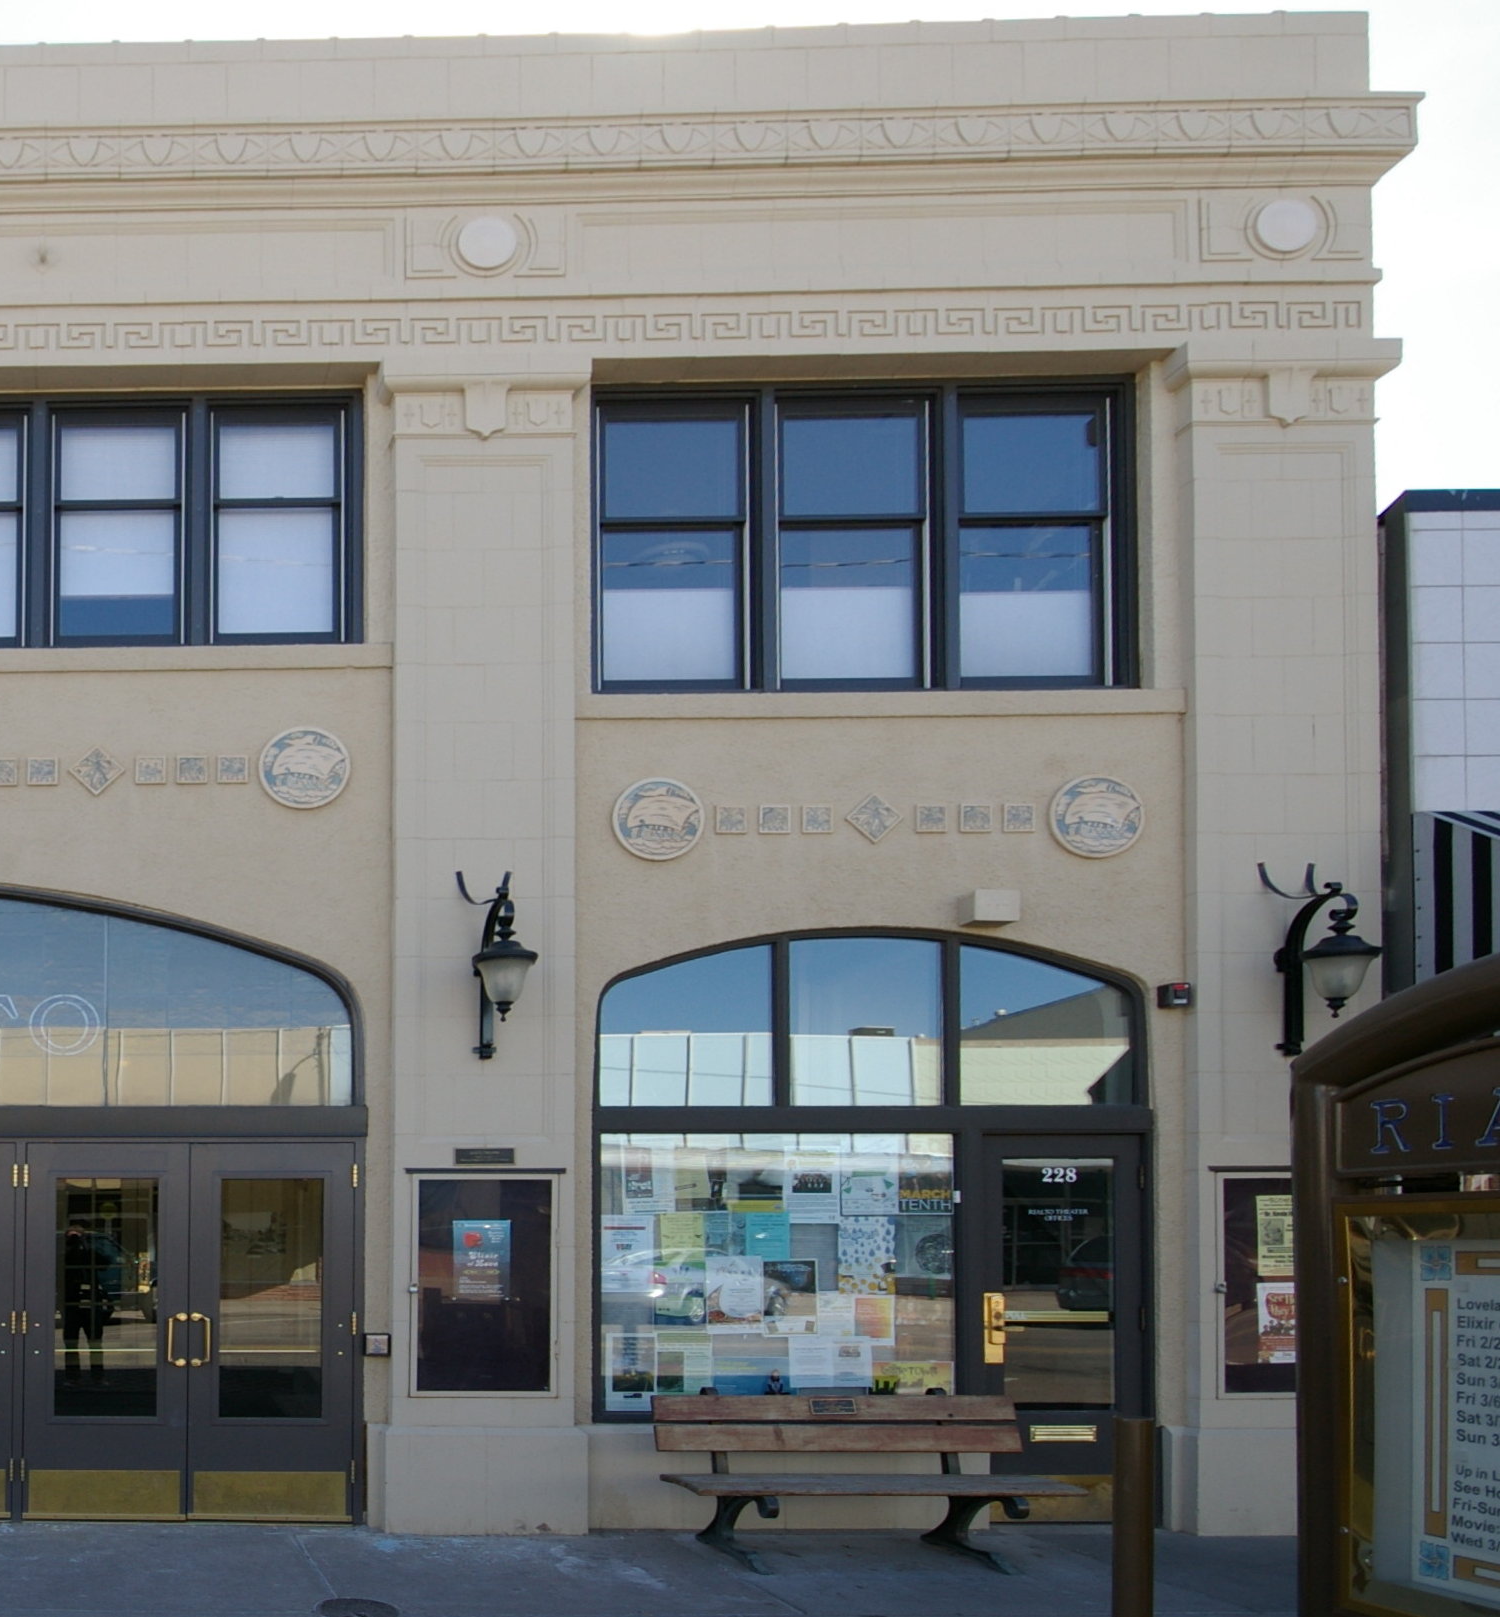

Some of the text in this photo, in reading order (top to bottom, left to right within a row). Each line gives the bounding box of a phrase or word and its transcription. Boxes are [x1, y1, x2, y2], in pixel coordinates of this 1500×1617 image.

[1041, 1167, 1077, 1183] 228
[900, 1189, 952, 1199] MARCH
[899, 1199, 952, 1211] TENTH
[1457, 1315, 1495, 1330] Elixir
[1456, 1334, 1476, 1348] Fri
[1457, 1353, 1481, 1368] Sat
[1456, 1372, 1486, 1388] Sun
[1456, 1391, 1476, 1405] Fri
[1456, 1409, 1481, 1425] Sat
[1456, 1428, 1487, 1445] Sun
[1456, 1463, 1473, 1479] Up
[1476, 1466, 1488, 1480] in
[1453, 1480, 1481, 1496] See
[1451, 1531, 1483, 1548] Wed
